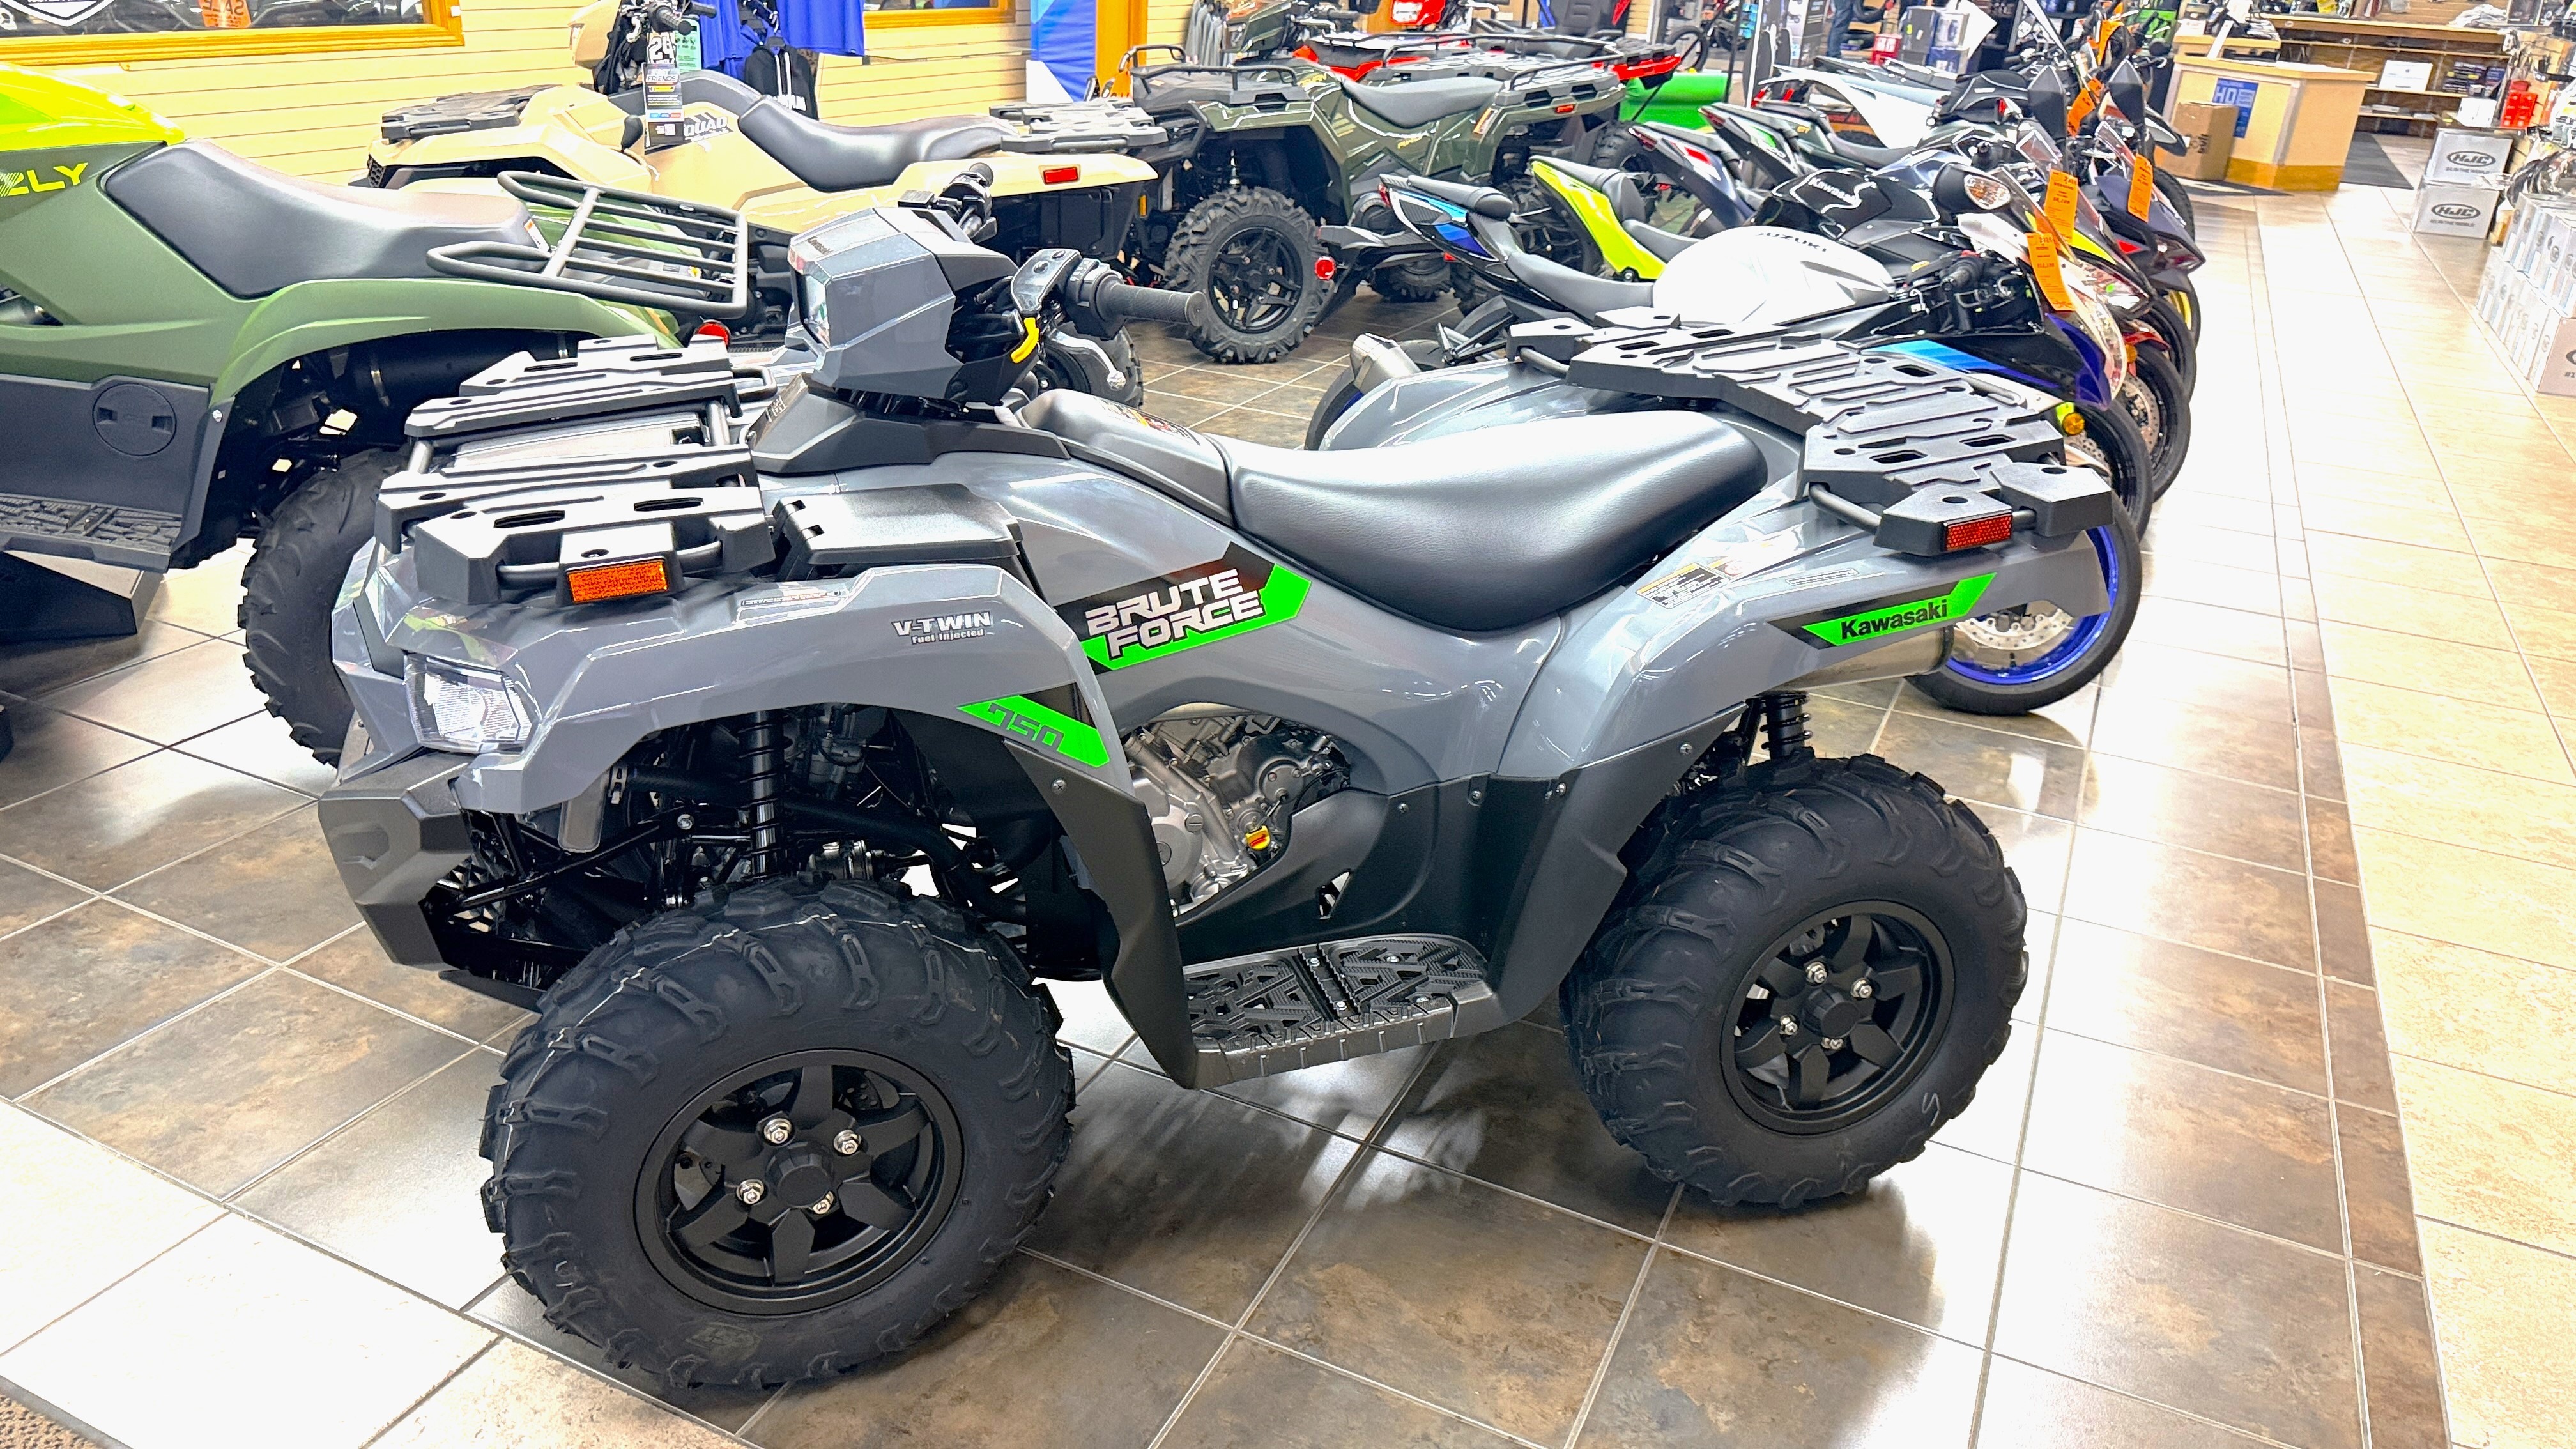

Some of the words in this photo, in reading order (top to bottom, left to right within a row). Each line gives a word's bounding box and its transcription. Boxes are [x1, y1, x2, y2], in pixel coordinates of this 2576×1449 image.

[684, 116, 728, 137] QUAD
[2451, 153, 2490, 164] HJC
[0, 162, 89, 197] ZLY
[2437, 206, 2475, 217] HJC
[1085, 569, 1243, 636] BRUTE
[892, 611, 991, 636] V-TWIN
[1105, 590, 1264, 658] FORCE
[1841, 599, 1947, 640] Kawasaki
[912, 635, 936, 645] Fuel
[938, 628, 985, 642] Injected
[987, 702, 1064, 751] 750
